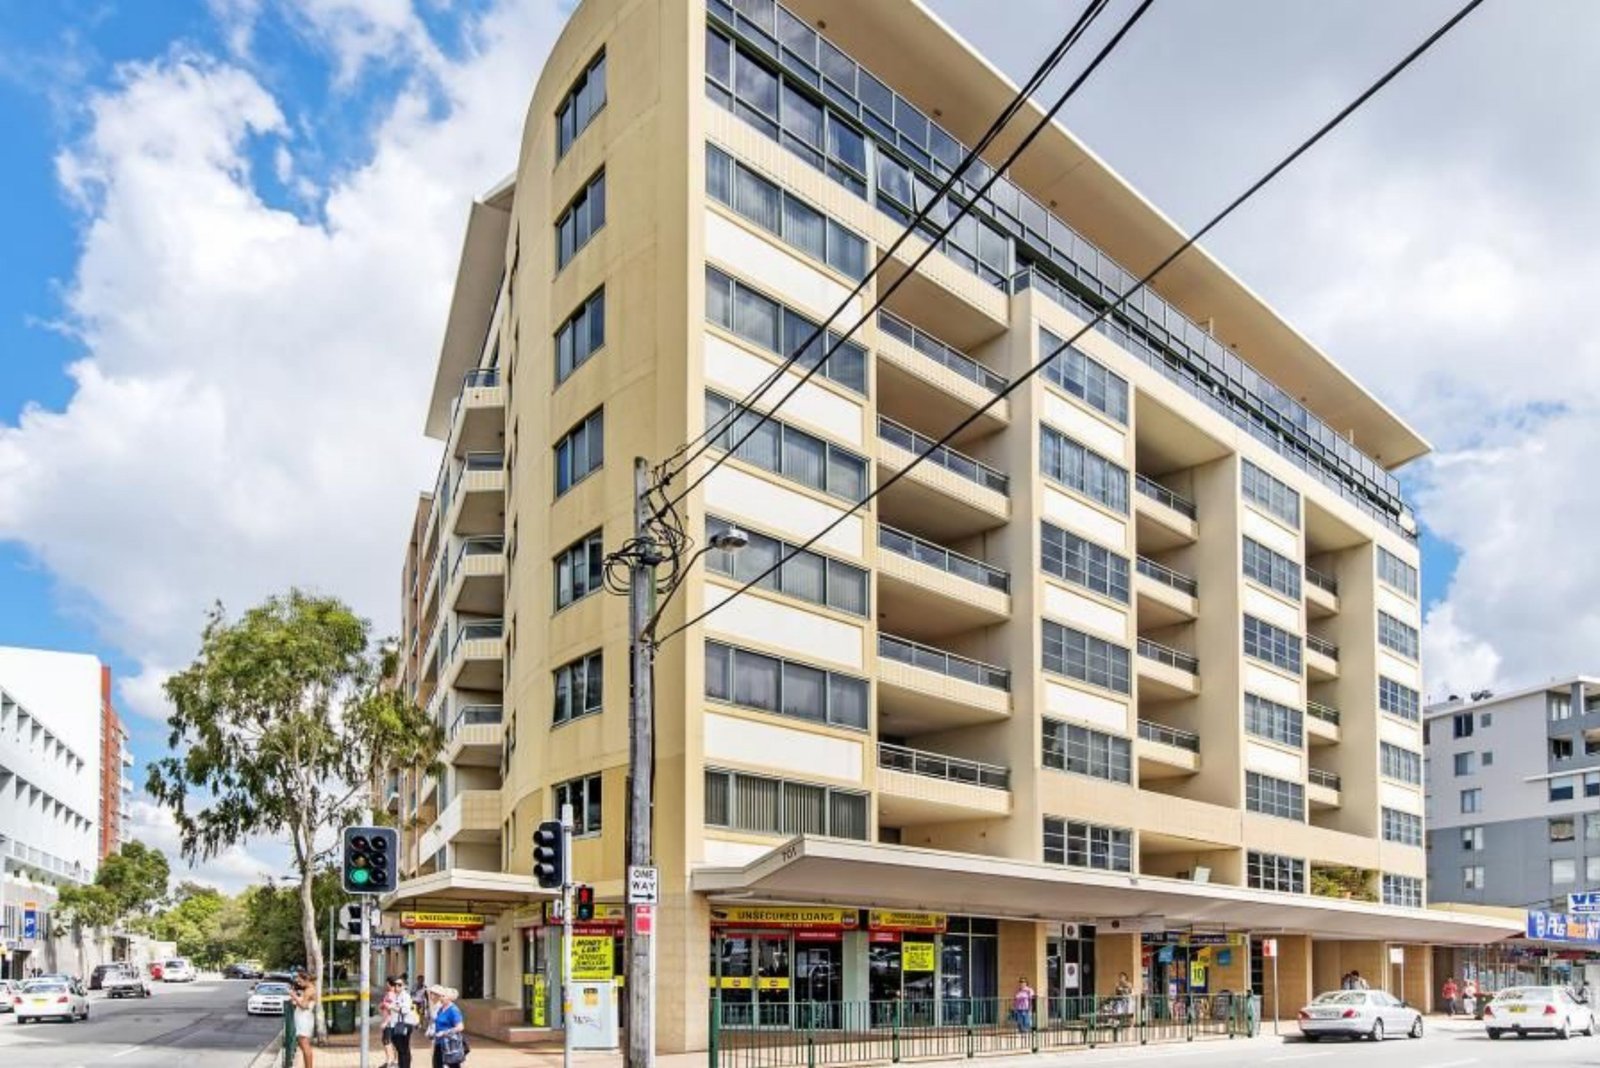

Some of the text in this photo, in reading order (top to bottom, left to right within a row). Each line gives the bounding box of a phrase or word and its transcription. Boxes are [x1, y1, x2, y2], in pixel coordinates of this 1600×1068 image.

[633, 869, 654, 880] ONE
[632, 881, 656, 891] WAY
[737, 910, 799, 921] UNSECURED
[800, 911, 835, 921] LOANS
